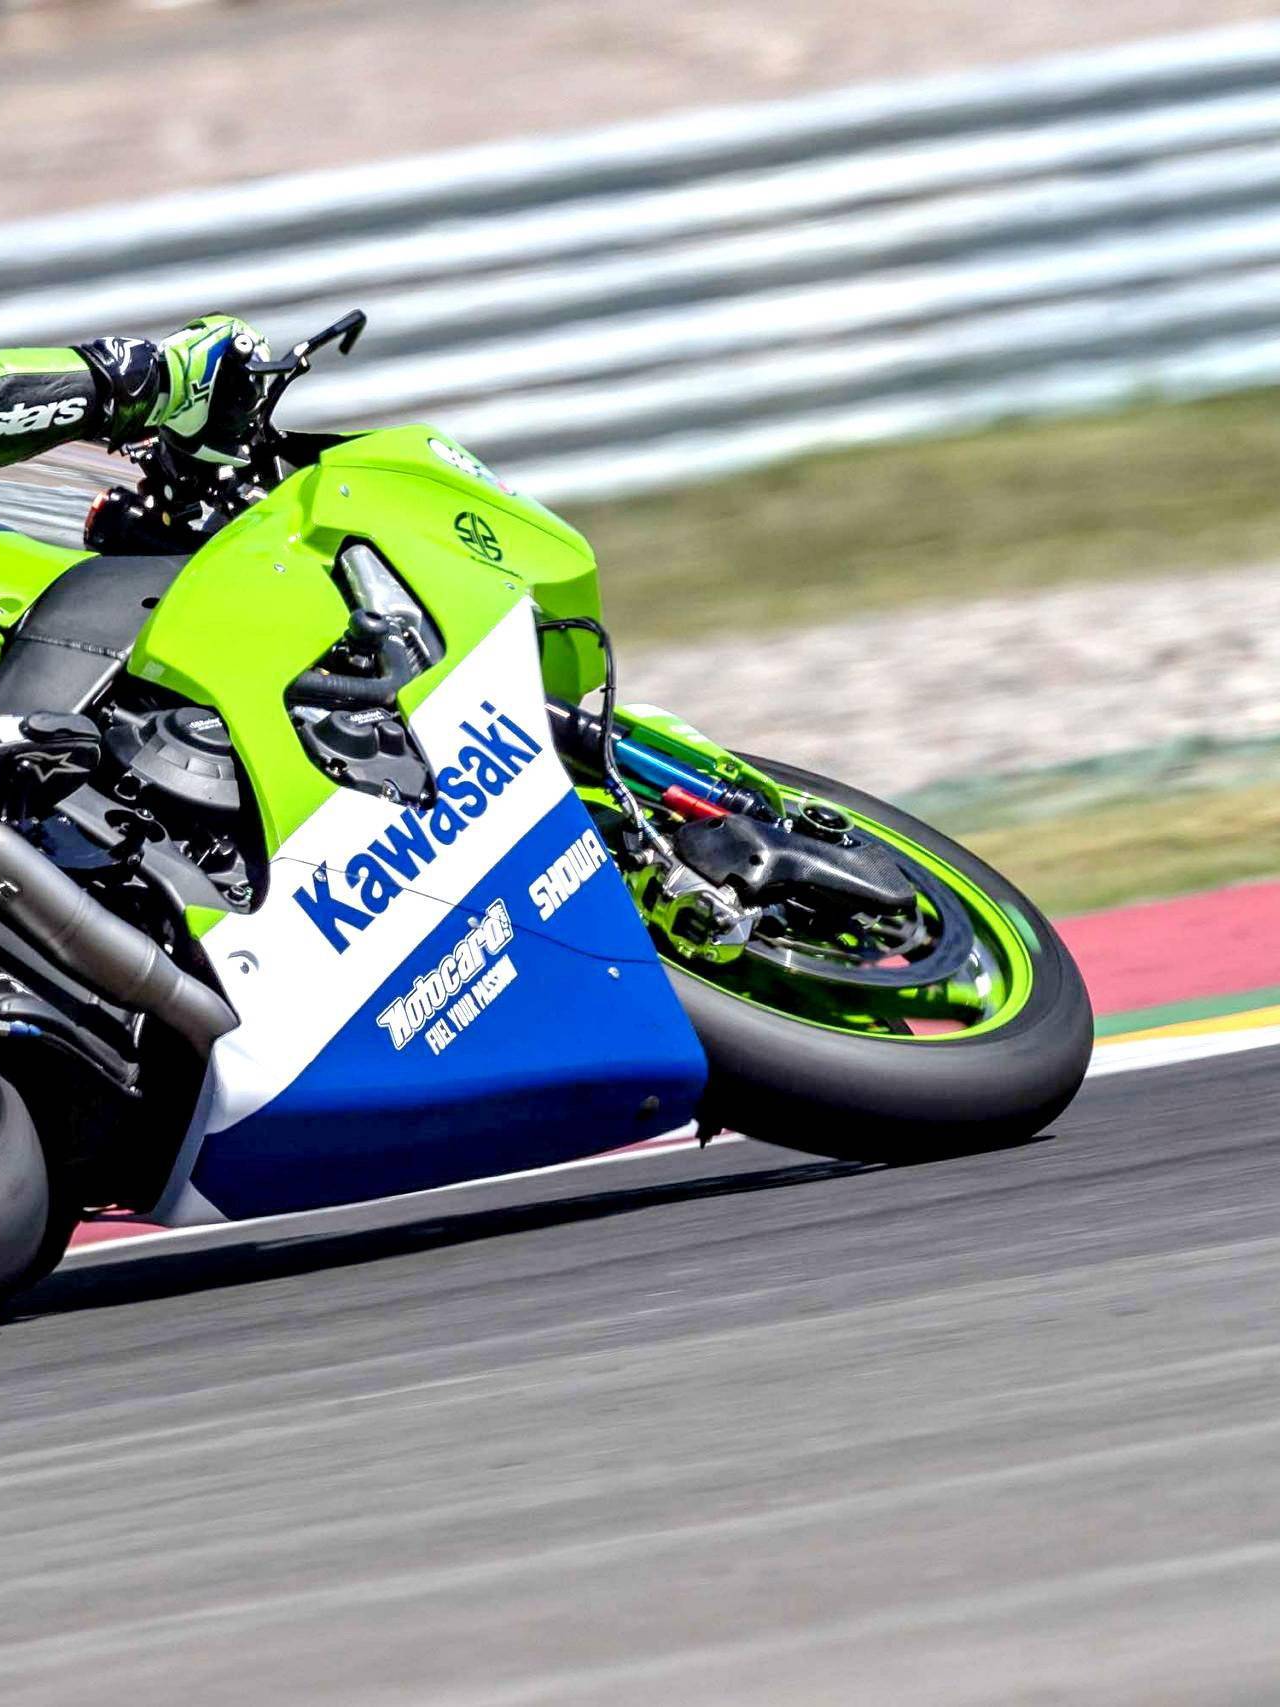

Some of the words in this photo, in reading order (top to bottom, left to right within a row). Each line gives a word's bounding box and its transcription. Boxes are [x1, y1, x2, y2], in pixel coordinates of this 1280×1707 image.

[291, 700, 543, 955] Kawasaki
[528, 828, 608, 922] SHOWA
[424, 1017, 457, 1056] FUEL
[446, 993, 481, 1032] YOUR
